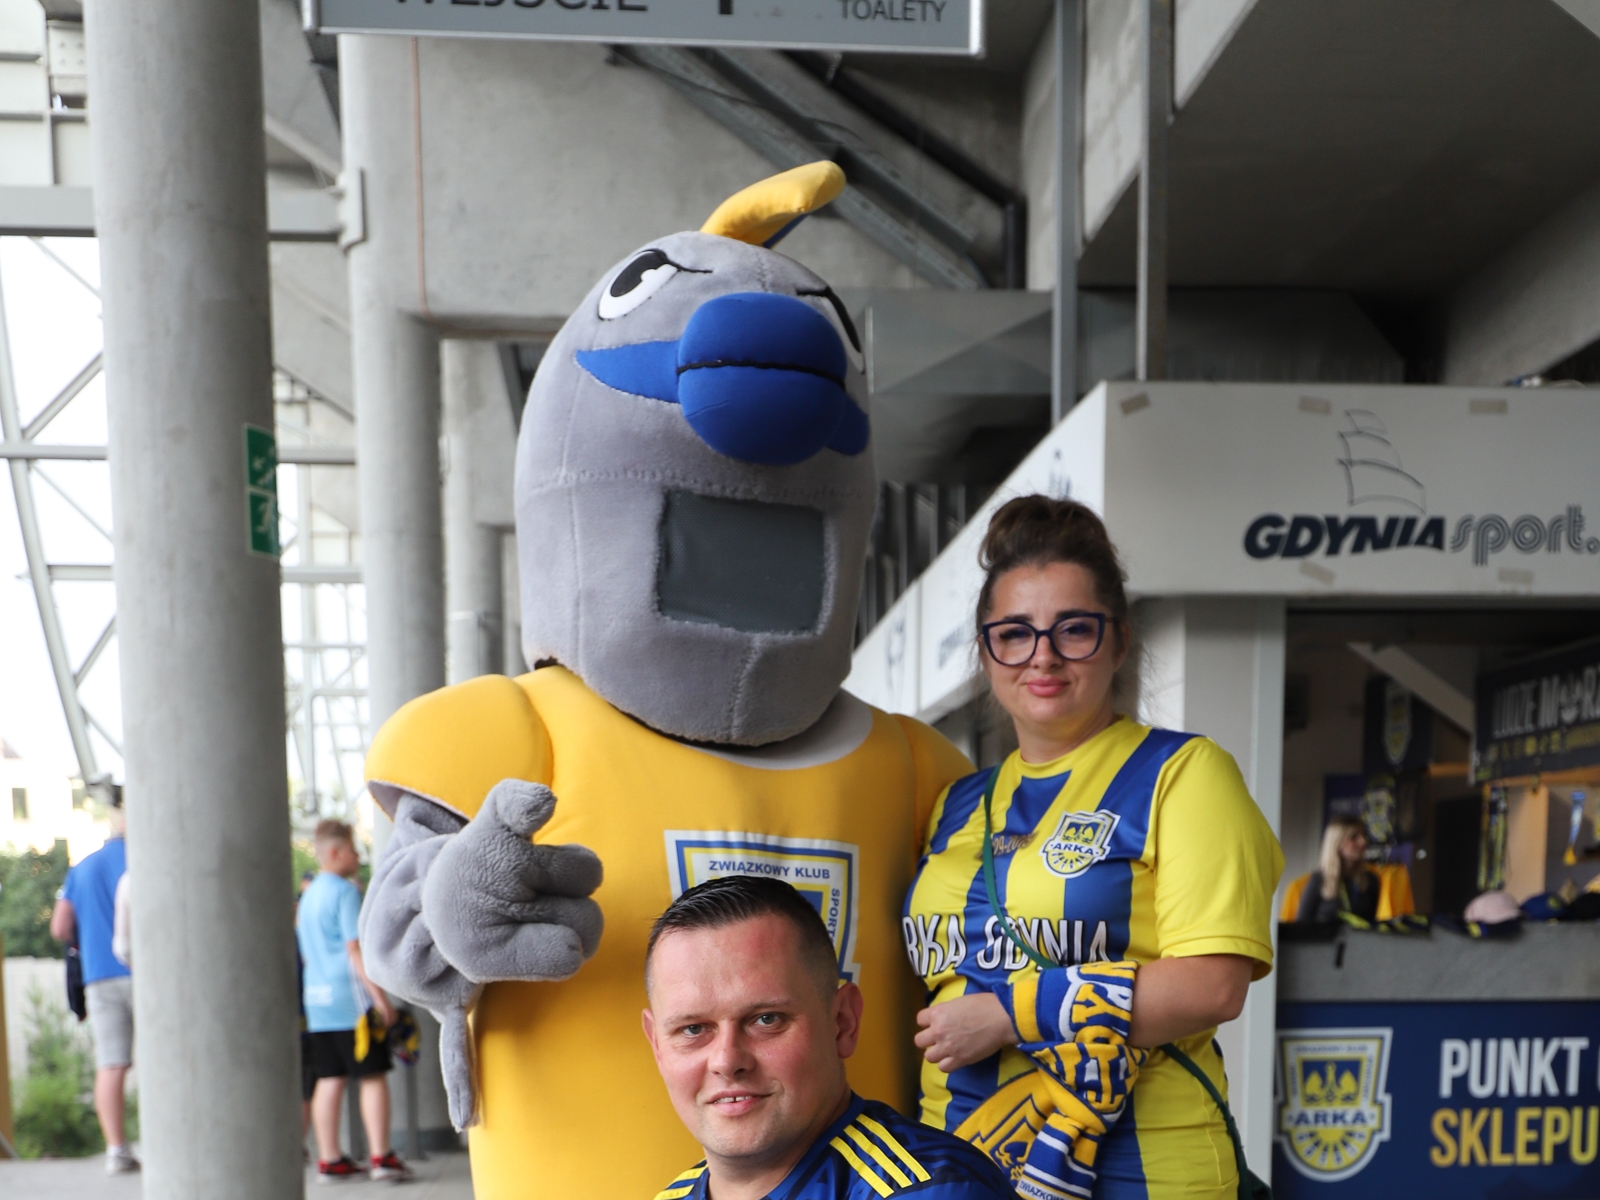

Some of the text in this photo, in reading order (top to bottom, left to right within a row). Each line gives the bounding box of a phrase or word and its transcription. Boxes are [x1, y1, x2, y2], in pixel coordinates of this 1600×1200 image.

[841, 0, 947, 22] TOALETY
[1053, 843, 1094, 856] ARKA
[709, 860, 831, 879] ZWIĄZKOWY KLUB
[827, 888, 840, 942] SPORT
[1439, 1036, 1589, 1099] PUNKT
[1294, 1110, 1367, 1126] ARKA
[1430, 1105, 1599, 1168] SKLEPU
